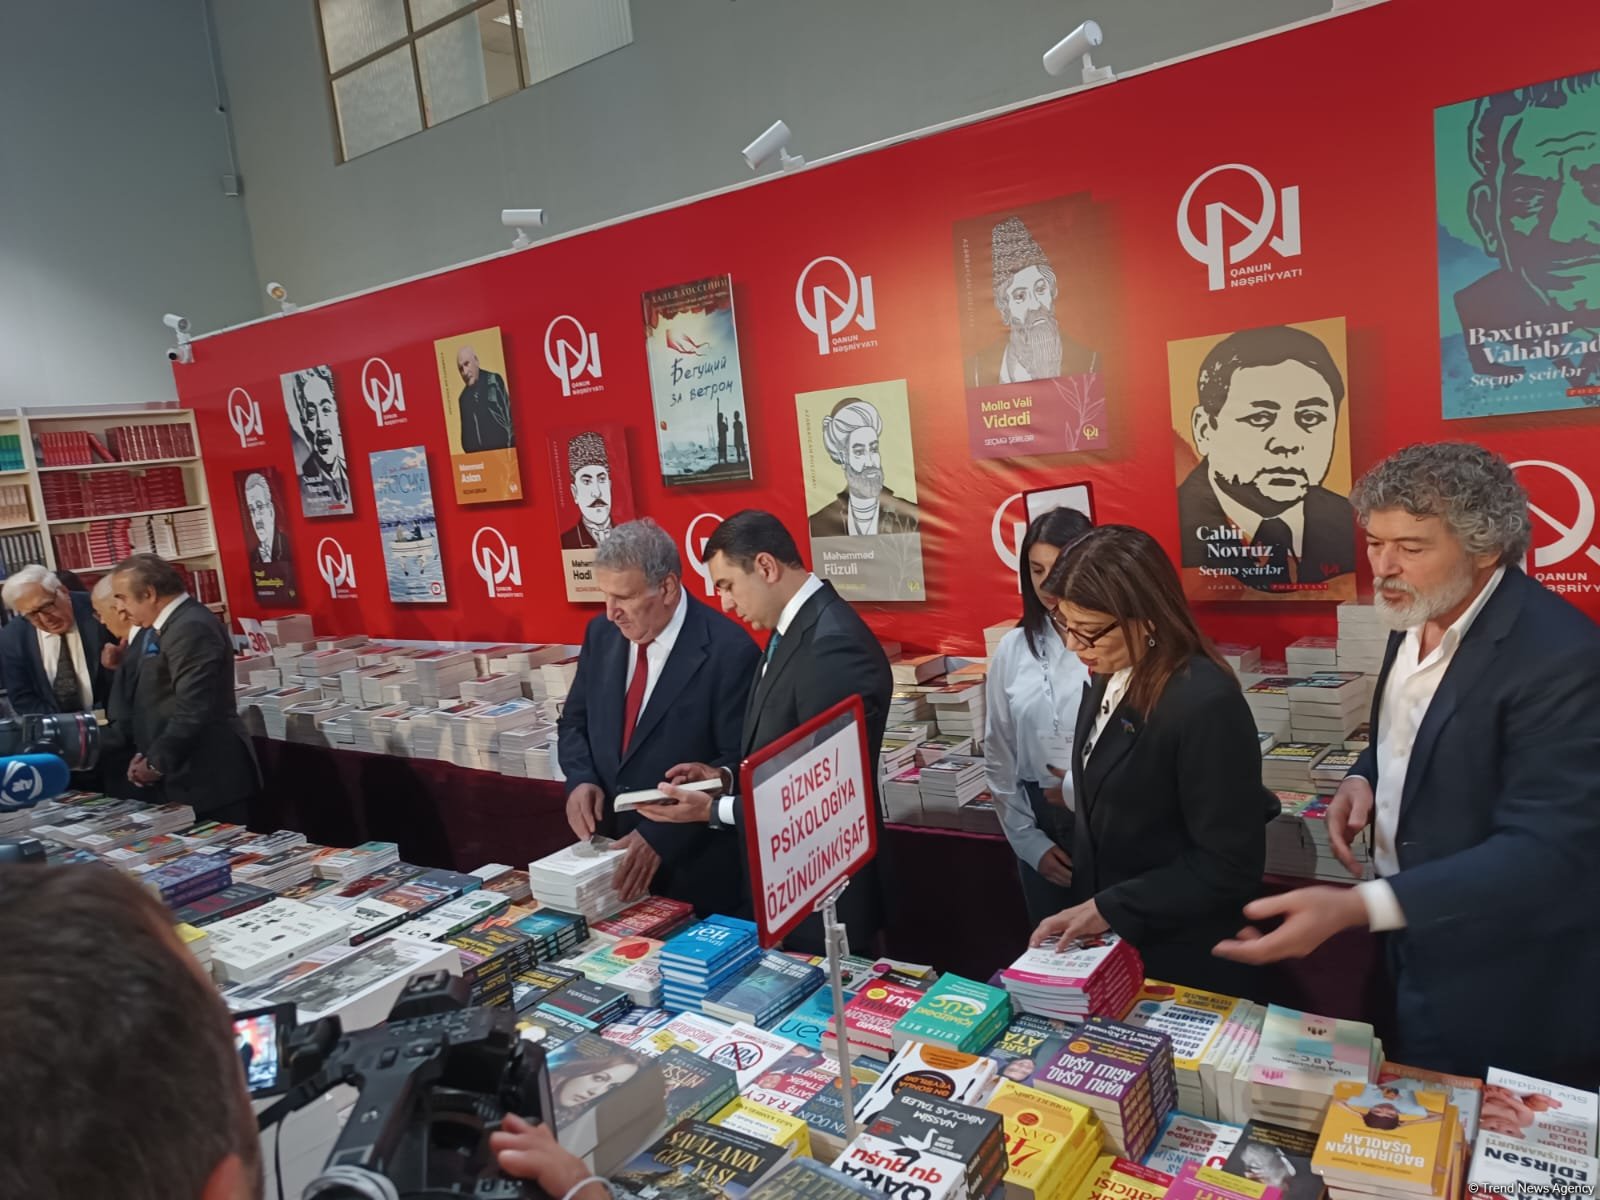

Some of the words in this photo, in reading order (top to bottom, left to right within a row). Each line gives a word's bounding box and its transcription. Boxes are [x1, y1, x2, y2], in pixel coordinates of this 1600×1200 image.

[1230, 262, 1273, 278] QANUN
[1230, 267, 1303, 288] NƏŞRİYYATI
[832, 334, 859, 346] QANUN
[1469, 320, 1574, 346] Bəxtiyar
[671, 356, 728, 386] Бегущий
[689, 379, 734, 400] ветром
[1470, 372, 1525, 391] Seçmə
[981, 400, 1011, 412] Molla
[1012, 396, 1033, 408] Vəli
[983, 410, 1031, 429] Vidadi
[1195, 523, 1246, 541] Cabir
[1207, 542, 1274, 558] Novruz
[824, 562, 858, 576] Füzuli
[1199, 565, 1239, 579] Seçmə
[1535, 571, 1587, 582] QANUN
[780, 756, 831, 813] BİZNES
[770, 777, 856, 863] PSİXOLOGİYA
[766, 815, 866, 921] ÖZÜNÜİNKİŞAF
[1057, 1053, 1093, 1075] UŞAQ
[1086, 1077, 1124, 1097] VARLI
[901, 1095, 933, 1112] TALEB
[912, 1111, 958, 1130] NASSİM
[935, 1106, 987, 1126] NİKOLAS
[1343, 1132, 1411, 1155] UŞAQLAR
[851, 1148, 907, 1173] quşu
[1324, 1140, 1425, 1168] BAĞIRMAYAN
[1484, 1146, 1588, 1181] EDİRSƏN
[908, 1165, 942, 1184] qu
